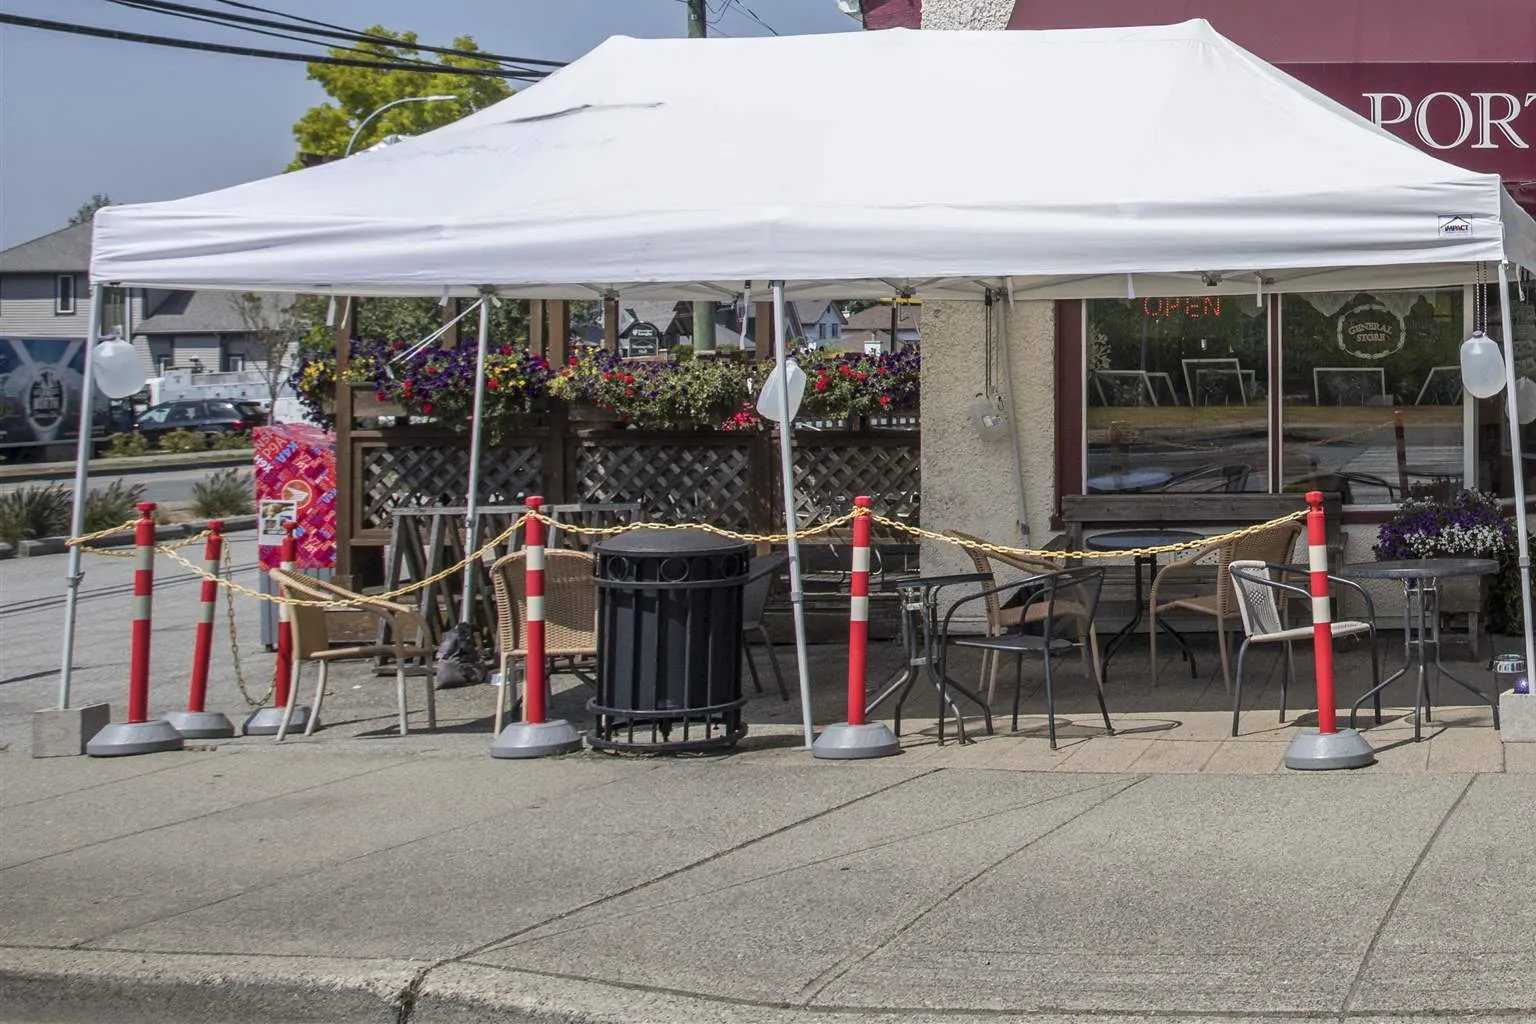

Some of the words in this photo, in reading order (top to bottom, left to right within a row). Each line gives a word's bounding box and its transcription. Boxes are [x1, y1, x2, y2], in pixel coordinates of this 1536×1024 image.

[1143, 295, 1222, 317] OPEN
[1348, 322, 1393, 335] GENERAL
[1356, 333, 1386, 343] STORE
